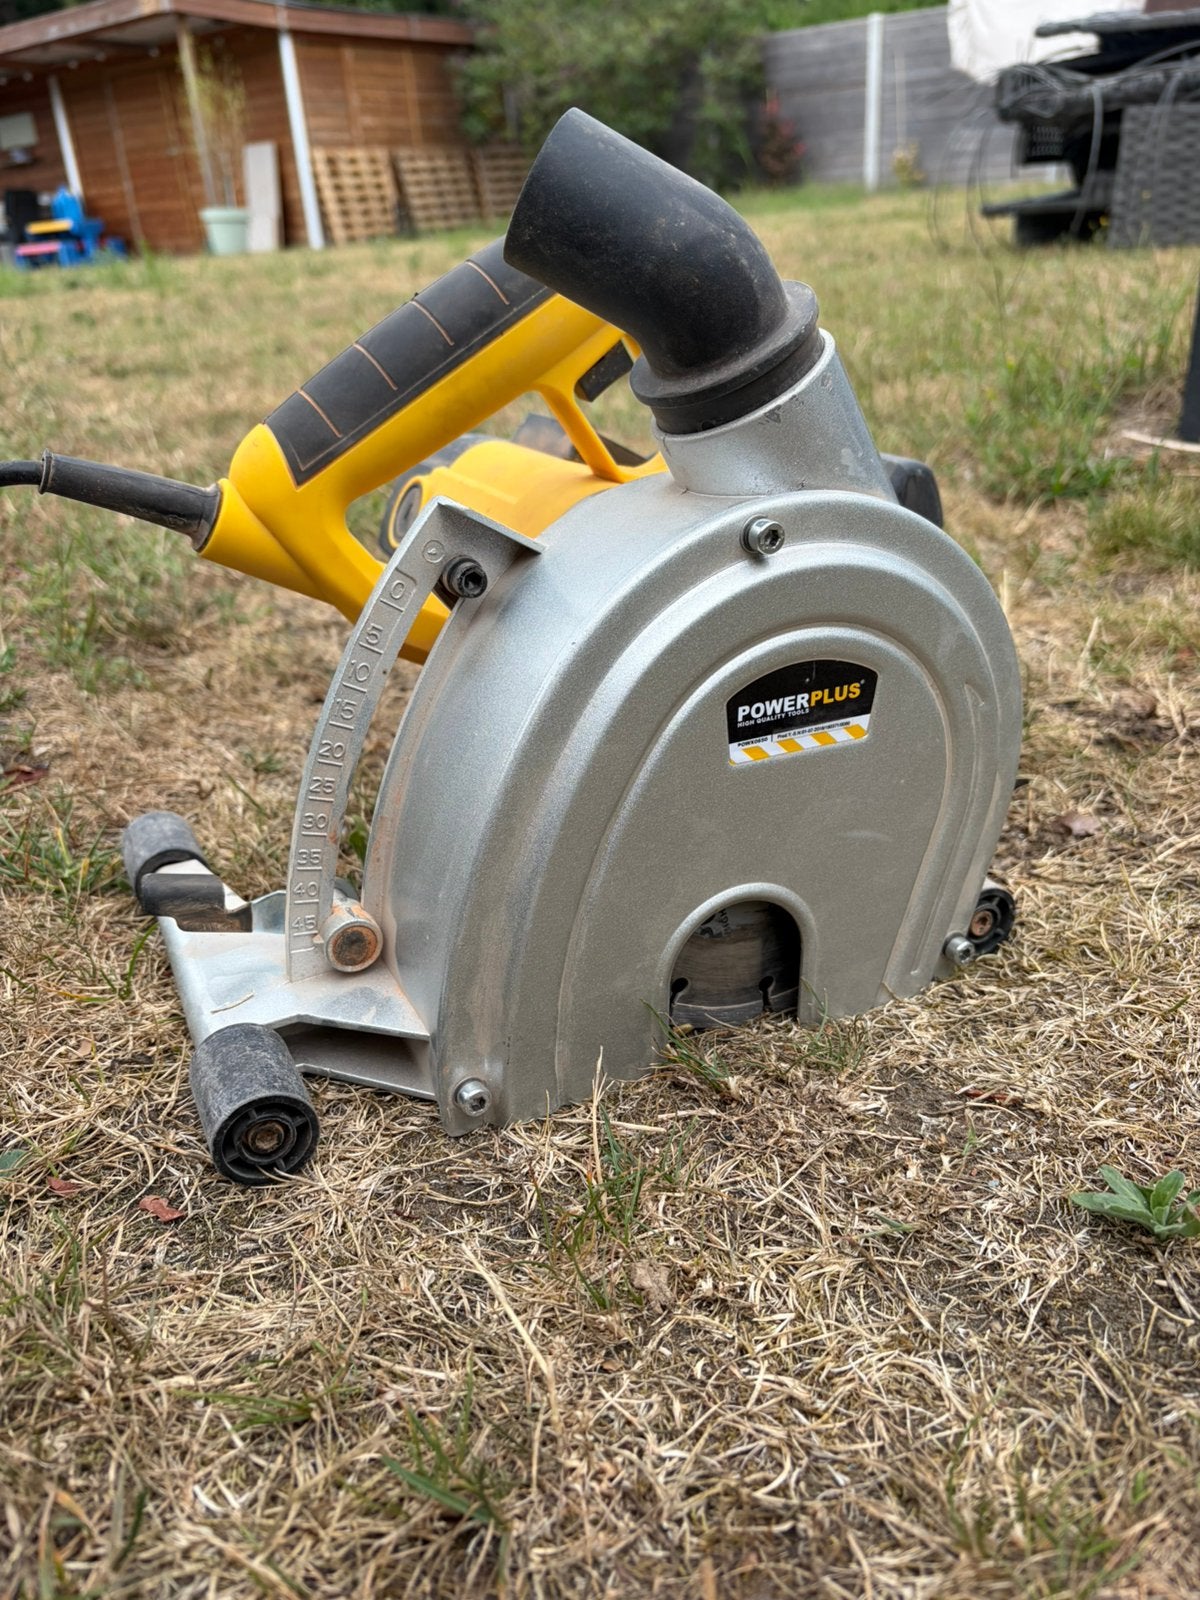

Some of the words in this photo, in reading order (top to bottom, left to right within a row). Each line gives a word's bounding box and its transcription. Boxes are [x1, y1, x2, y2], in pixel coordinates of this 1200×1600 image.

[366, 622, 384, 645] 5
[348, 660, 371, 683] 10
[334, 698, 357, 720] 15
[737, 682, 861, 722] POWERPLUS
[737, 719, 755, 728] HIGH
[756, 712, 786, 724] QUALITY
[788, 708, 810, 717] TOOLS
[318, 739, 346, 759] 20
[309, 776, 336, 794] 25
[302, 812, 329, 829] 30
[297, 849, 322, 865] 35
[293, 881, 319, 897] 40
[291, 914, 318, 931] 45
